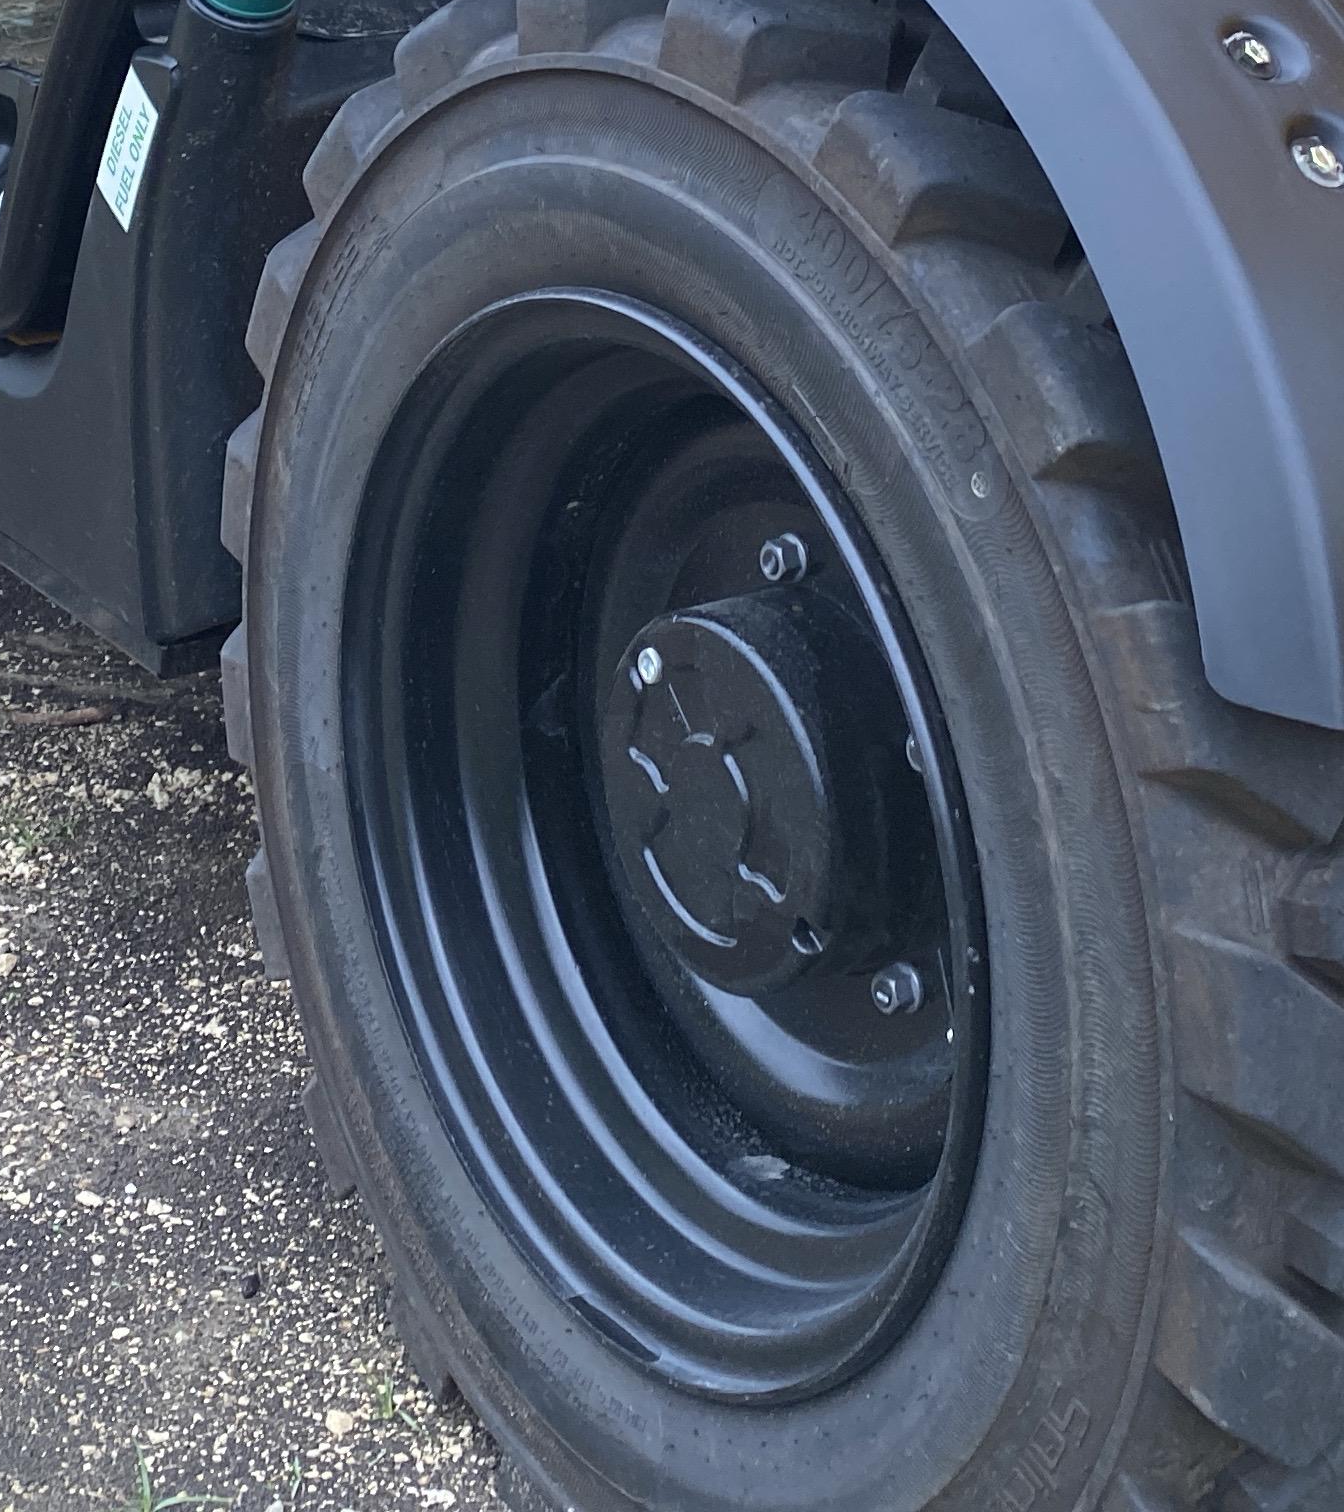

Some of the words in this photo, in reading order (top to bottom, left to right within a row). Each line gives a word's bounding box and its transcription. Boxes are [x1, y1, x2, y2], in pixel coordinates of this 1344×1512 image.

[106, 104, 133, 177] DIESEL
[114, 165, 135, 217] FUEL
[129, 102, 151, 162] ONLY
